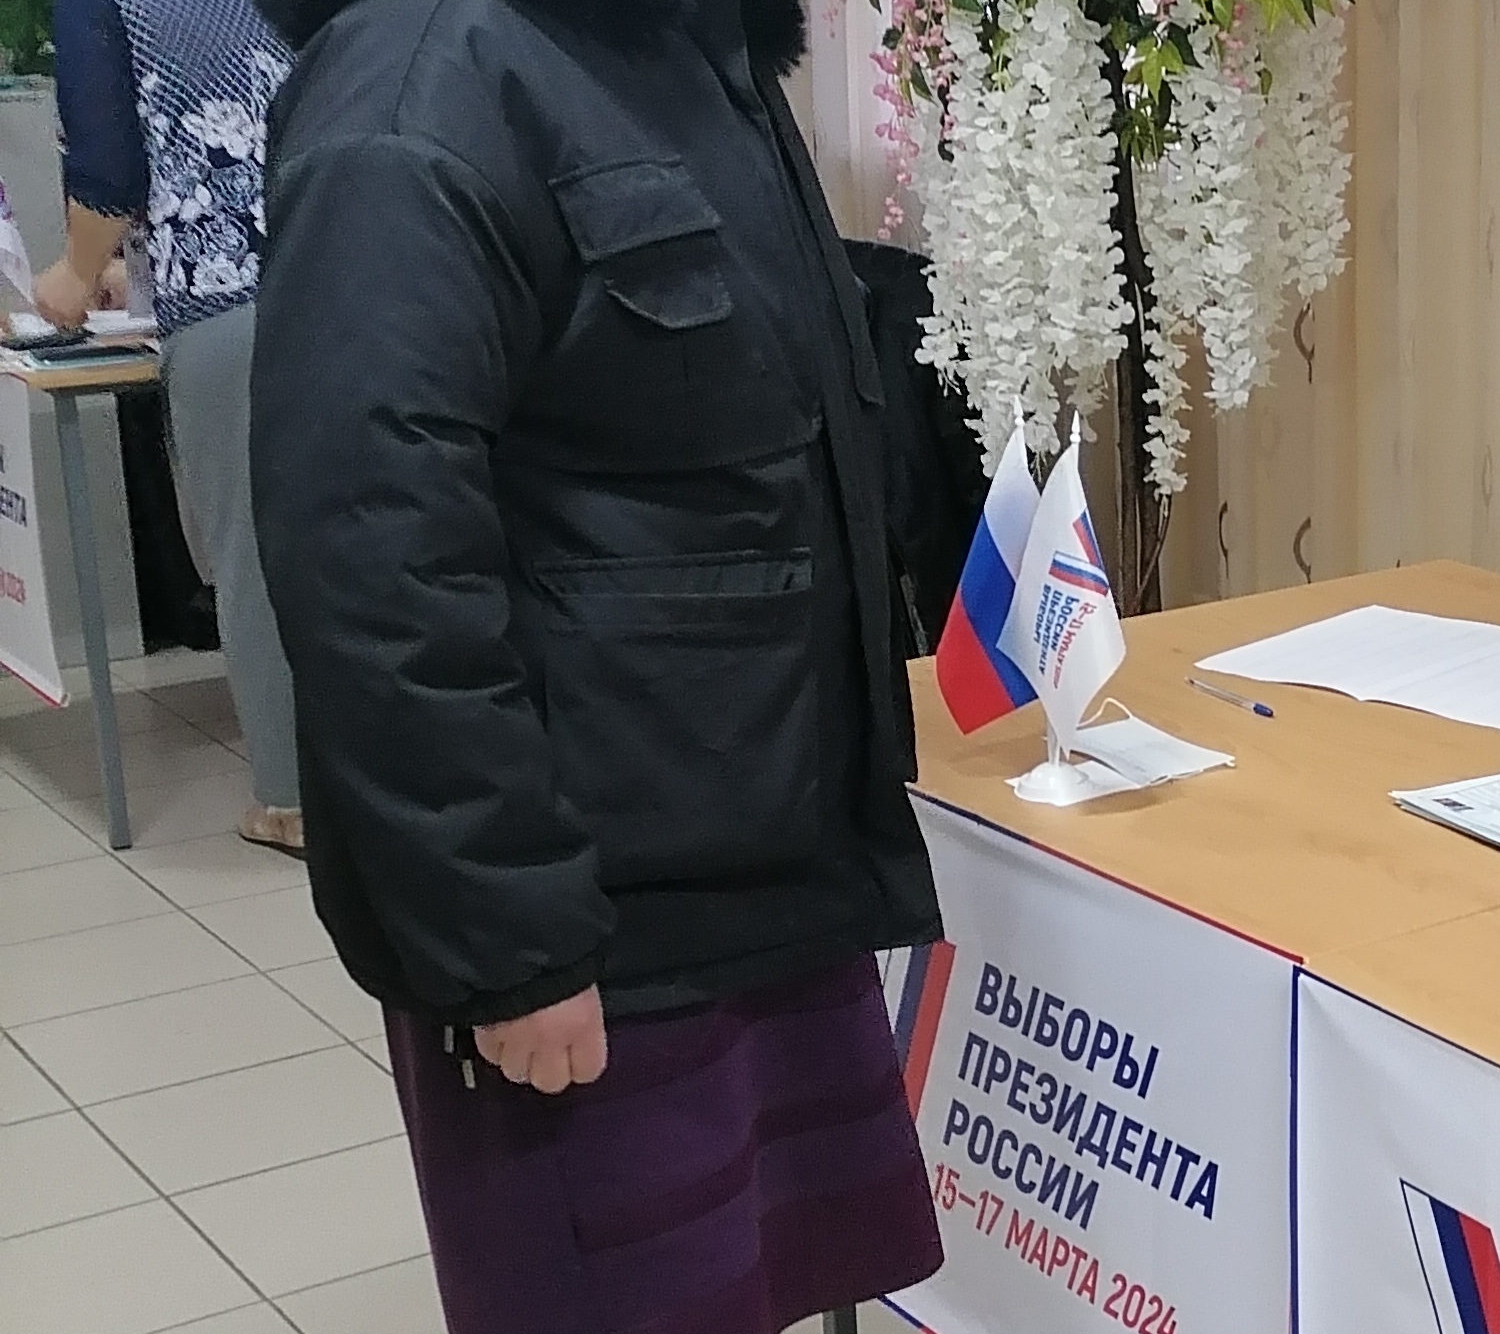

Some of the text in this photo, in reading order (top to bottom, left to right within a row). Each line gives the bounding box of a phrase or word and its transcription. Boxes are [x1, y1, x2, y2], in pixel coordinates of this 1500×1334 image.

[975, 962, 1160, 1099] ВЫБОРЫ
[943, 1098, 1099, 1231] РОССИИ
[958, 1031, 1220, 1220] ПРЕЗИДЕНТА
[1004, 1209, 1099, 1305] МАРТА
